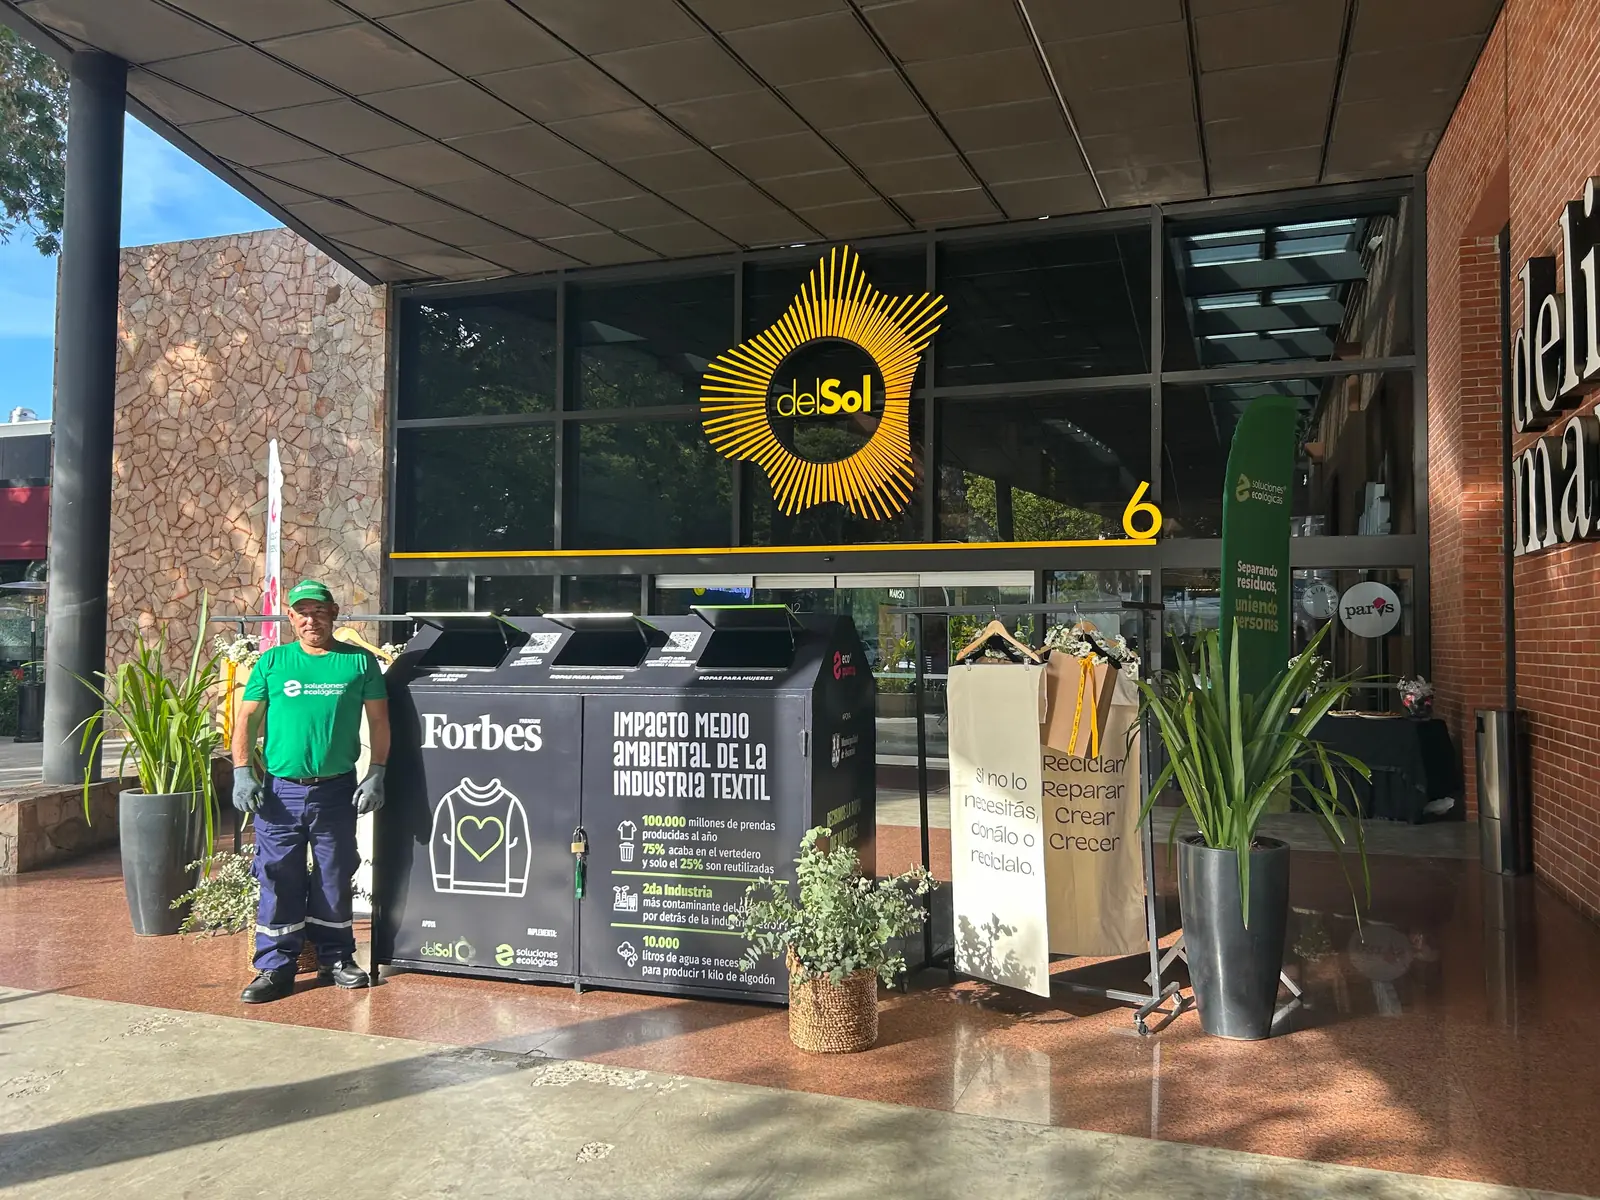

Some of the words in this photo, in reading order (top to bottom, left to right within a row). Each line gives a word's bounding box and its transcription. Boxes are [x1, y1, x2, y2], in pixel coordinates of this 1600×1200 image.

[776, 374, 871, 416] delSol
[1512, 403, 1600, 558] ma
[1122, 480, 1162, 539] 6
[1237, 559, 1278, 577] Separando
[1236, 574, 1277, 595] residuos,
[1235, 594, 1278, 616] uniendo
[1236, 615, 1279, 633] ersons
[421, 713, 543, 752] Forbes
[695, 712, 750, 739] MEDIO
[716, 742, 739, 769] DE
[1043, 755, 1125, 773] Reciclar
[711, 773, 771, 801] TEXTIL
[987, 772, 1008, 788] no
[1011, 772, 1028, 791] lo
[1041, 780, 1125, 801] Reparar
[964, 794, 1039, 824] necesitás,
[1055, 806, 1116, 826] Crear
[642, 814, 687, 828] 100.000
[688, 816, 725, 829] millones
[726, 818, 739, 829] de
[740, 820, 776, 832] prendas
[642, 829, 690, 841] producidas
[690, 831, 700, 842] al
[701, 831, 718, 842] año
[971, 821, 1019, 845] donálo
[1023, 833, 1035, 848] o
[1049, 832, 1121, 852] Crecer
[642, 843, 666, 856] 75%
[668, 845, 694, 856] acaba
[695, 849, 707, 857] en
[708, 847, 717, 857] el
[718, 848, 761, 860] vertedero
[642, 858, 649, 869] y
[649, 857, 668, 868] solo
[669, 859, 678, 869] el
[680, 858, 704, 871] 25%
[705, 862, 722, 871] son
[723, 861, 775, 874] reutilizadas
[642, 882, 663, 896] 2da
[664, 884, 713, 899] Industria
[643, 896, 661, 908] más
[662, 899, 721, 912] contaminante
[722, 902, 737, 913] del
[642, 911, 659, 923] por
[659, 911, 687, 924] detrás
[688, 913, 699, 925] de
[701, 914, 710, 925] la
[711, 914, 751, 928] indutri
[420, 941, 453, 958] delSol
[642, 935, 680, 950] 10.000
[515, 957, 559, 967] ecológicas
[516, 947, 559, 959] soluciones
[642, 949, 665, 962] litros
[666, 951, 678, 964] de
[678, 955, 700, 967] agua
[701, 957, 712, 966] se
[713, 957, 756, 969] necesan
[642, 965, 661, 977] para
[663, 967, 700, 979] producir
[701, 969, 707, 979] 1
[707, 969, 724, 980] kilo
[726, 971, 738, 982] de
[739, 972, 776, 985] algodón
